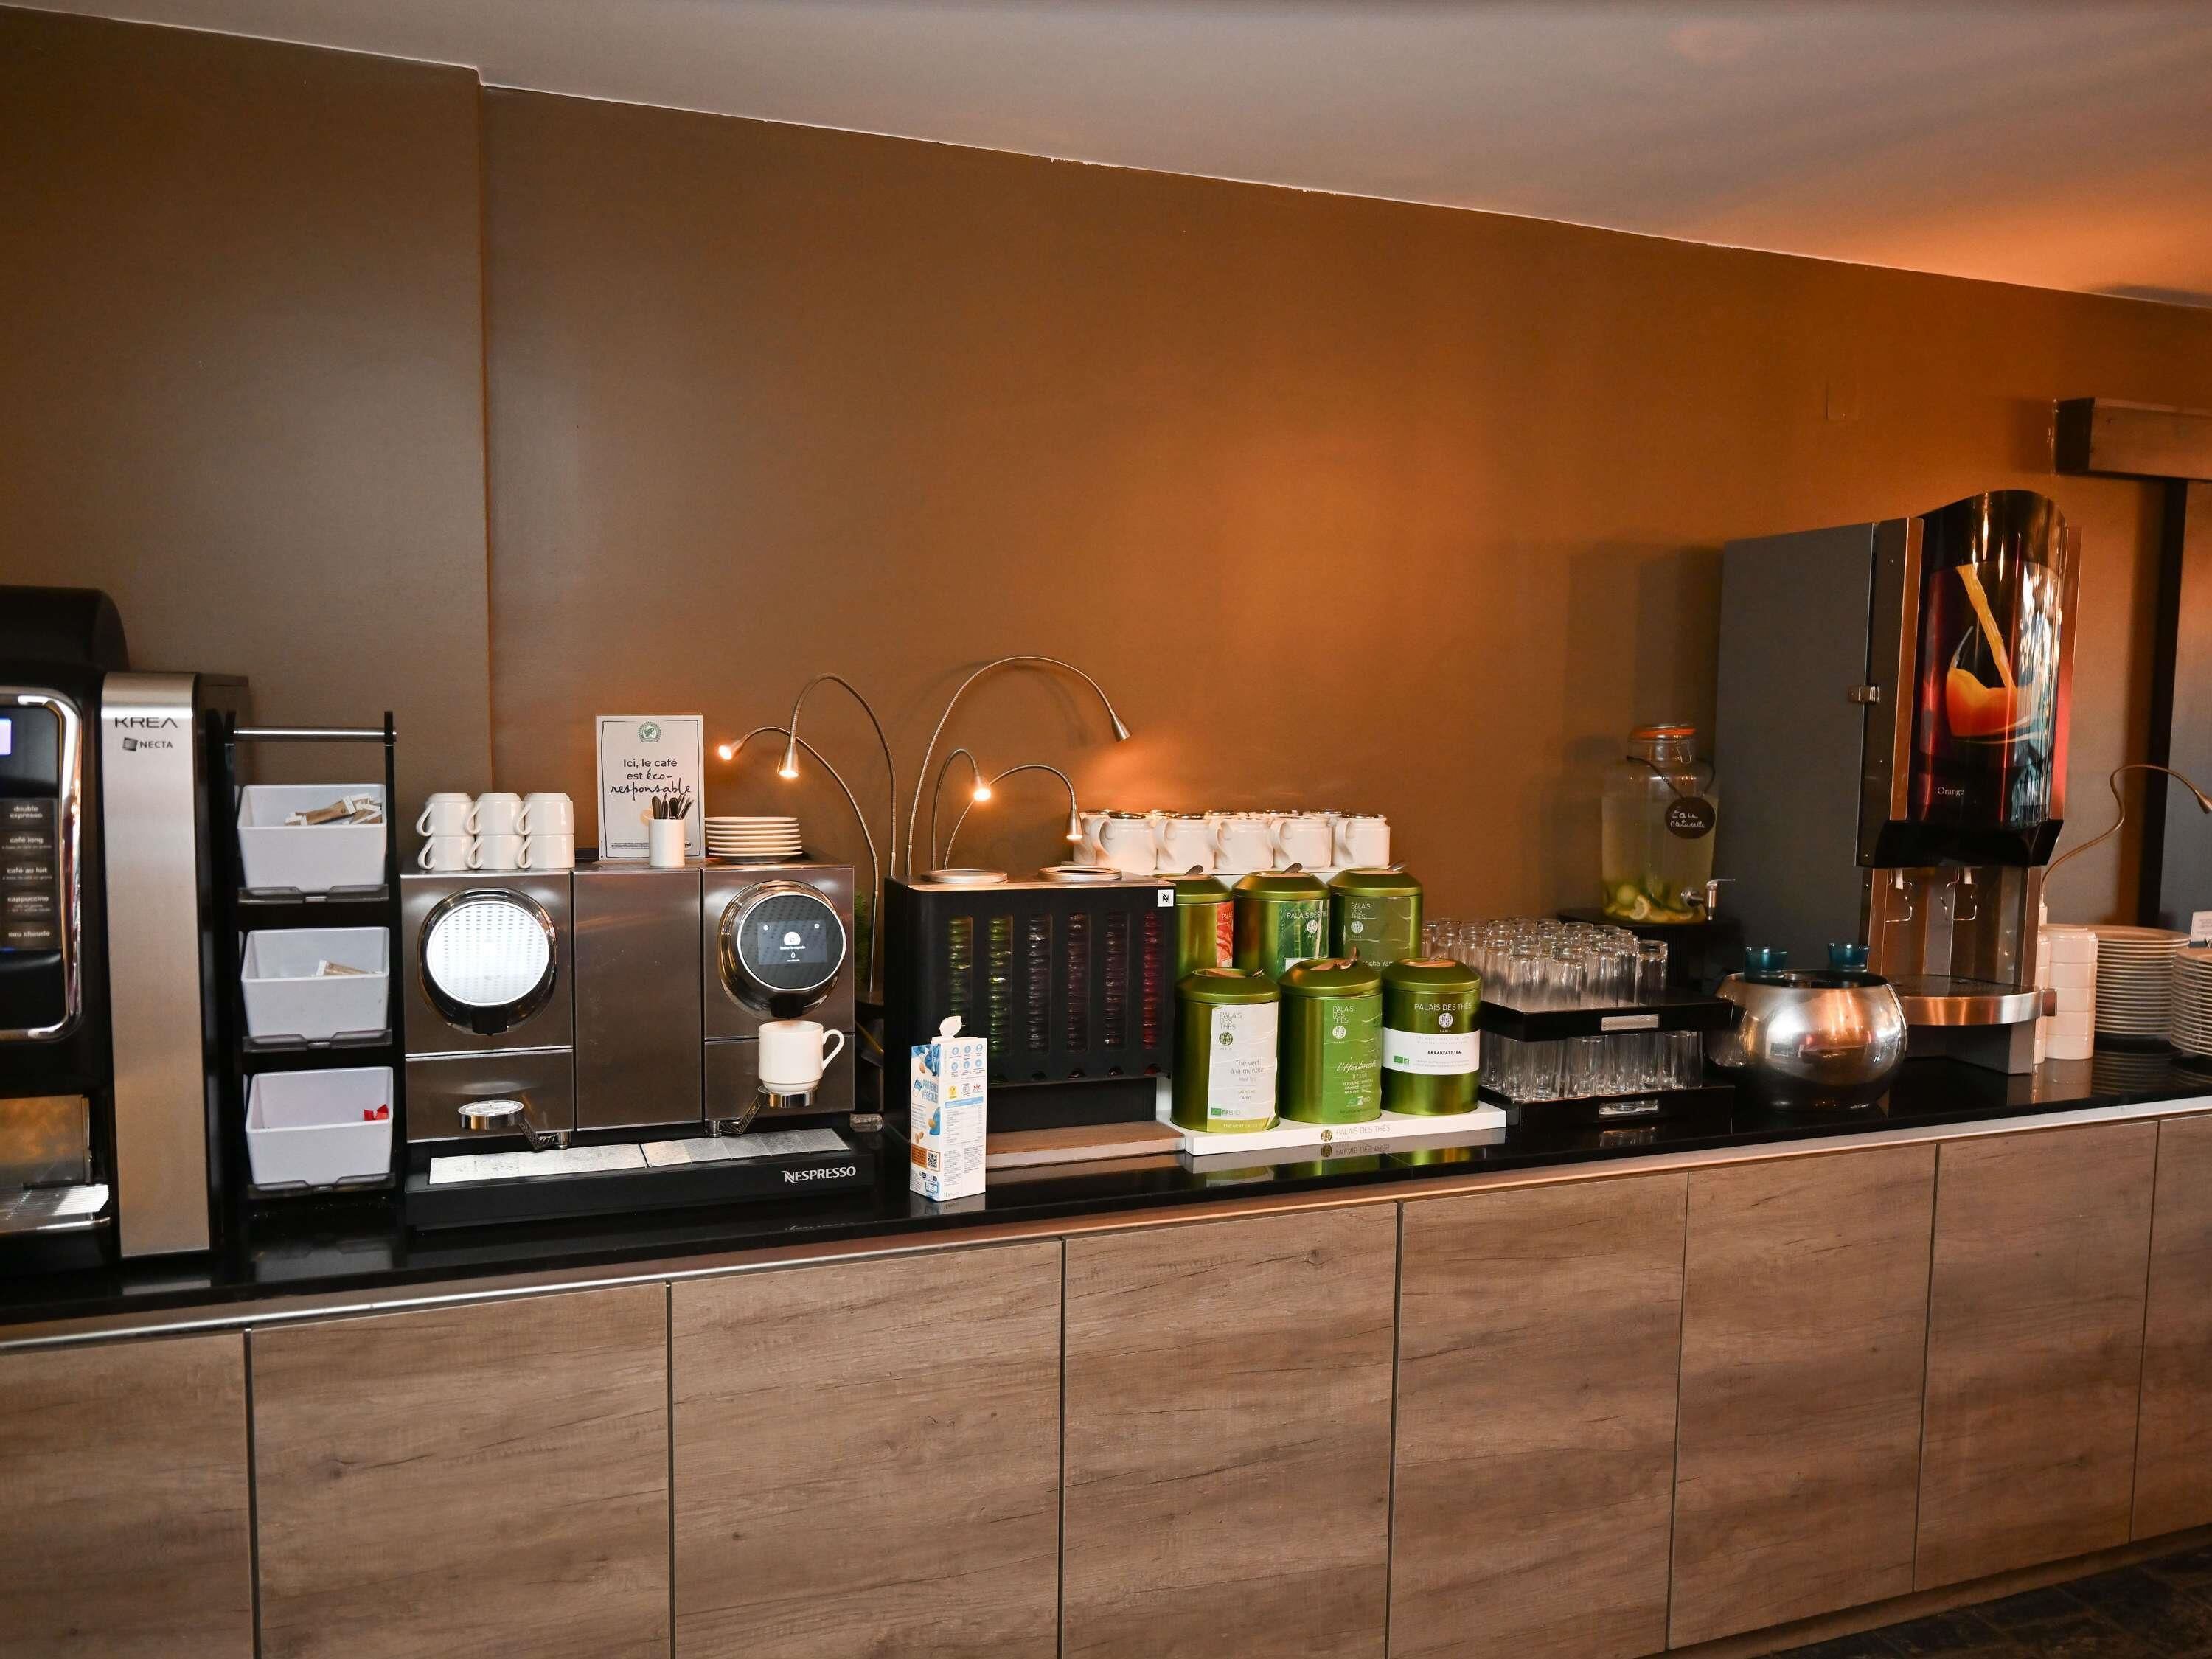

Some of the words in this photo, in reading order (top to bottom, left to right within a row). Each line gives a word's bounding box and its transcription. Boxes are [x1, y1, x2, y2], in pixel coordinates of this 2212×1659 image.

[114, 717, 178, 728] KREA
[139, 740, 173, 749] NECTA
[623, 758, 639, 769] Ici,
[641, 758, 651, 768] le
[654, 758, 678, 768] café
[626, 772, 644, 780] est
[646, 768, 673, 780] éco-
[610, 777, 691, 801] responsable
[1937, 786, 1964, 797] Orange
[27, 836, 44, 844] long
[7, 895, 49, 903] cappuccino
[1286, 911, 1310, 919] PALAIS
[1413, 1003, 1441, 1011] PALAIS
[1442, 1003, 1456, 1011] DES
[1220, 1011, 1242, 1019] PALAIS
[1335, 1127, 1358, 1135] PALAIS
[781, 1166, 856, 1184] NESPRESSO
